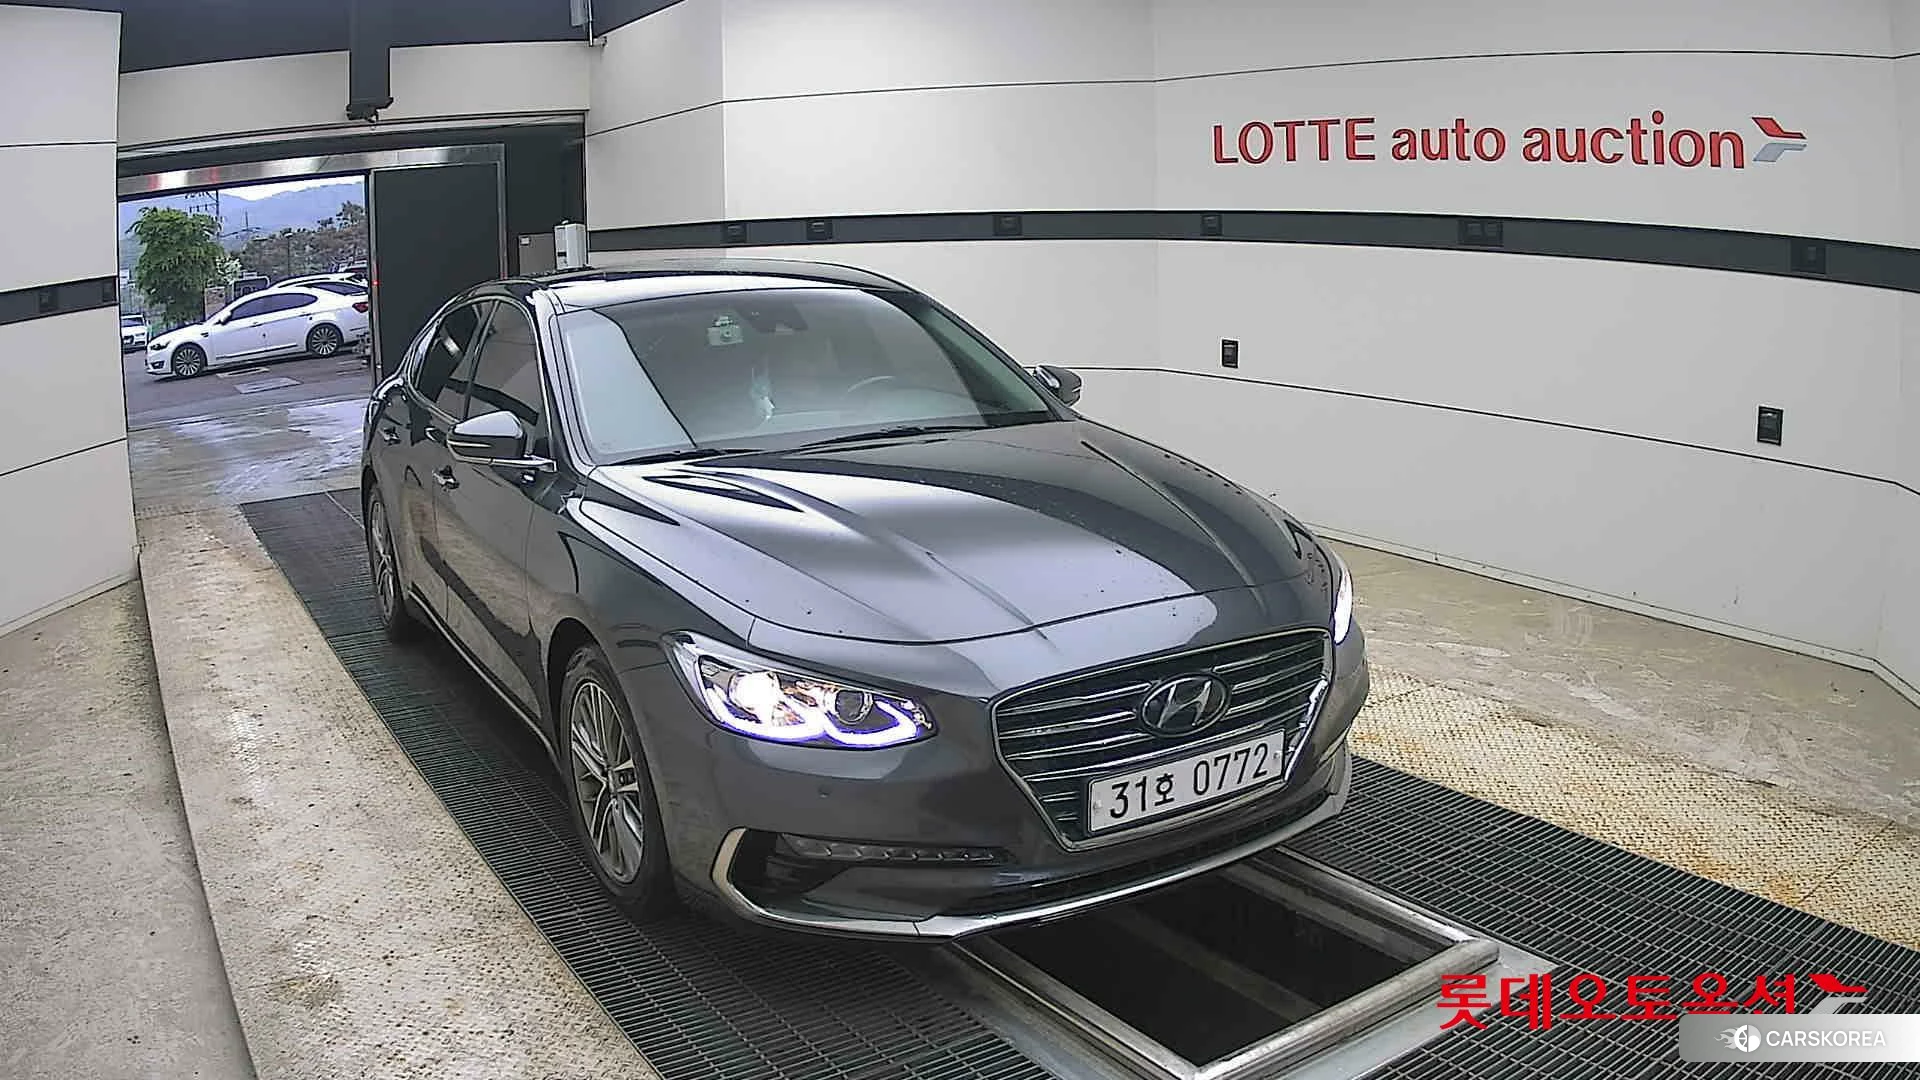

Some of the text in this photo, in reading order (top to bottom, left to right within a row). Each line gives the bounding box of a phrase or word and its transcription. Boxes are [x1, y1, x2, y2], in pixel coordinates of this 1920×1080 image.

[1213, 111, 1746, 169] LOTTE auto auction
[1109, 743, 1269, 819] 31호 0772
